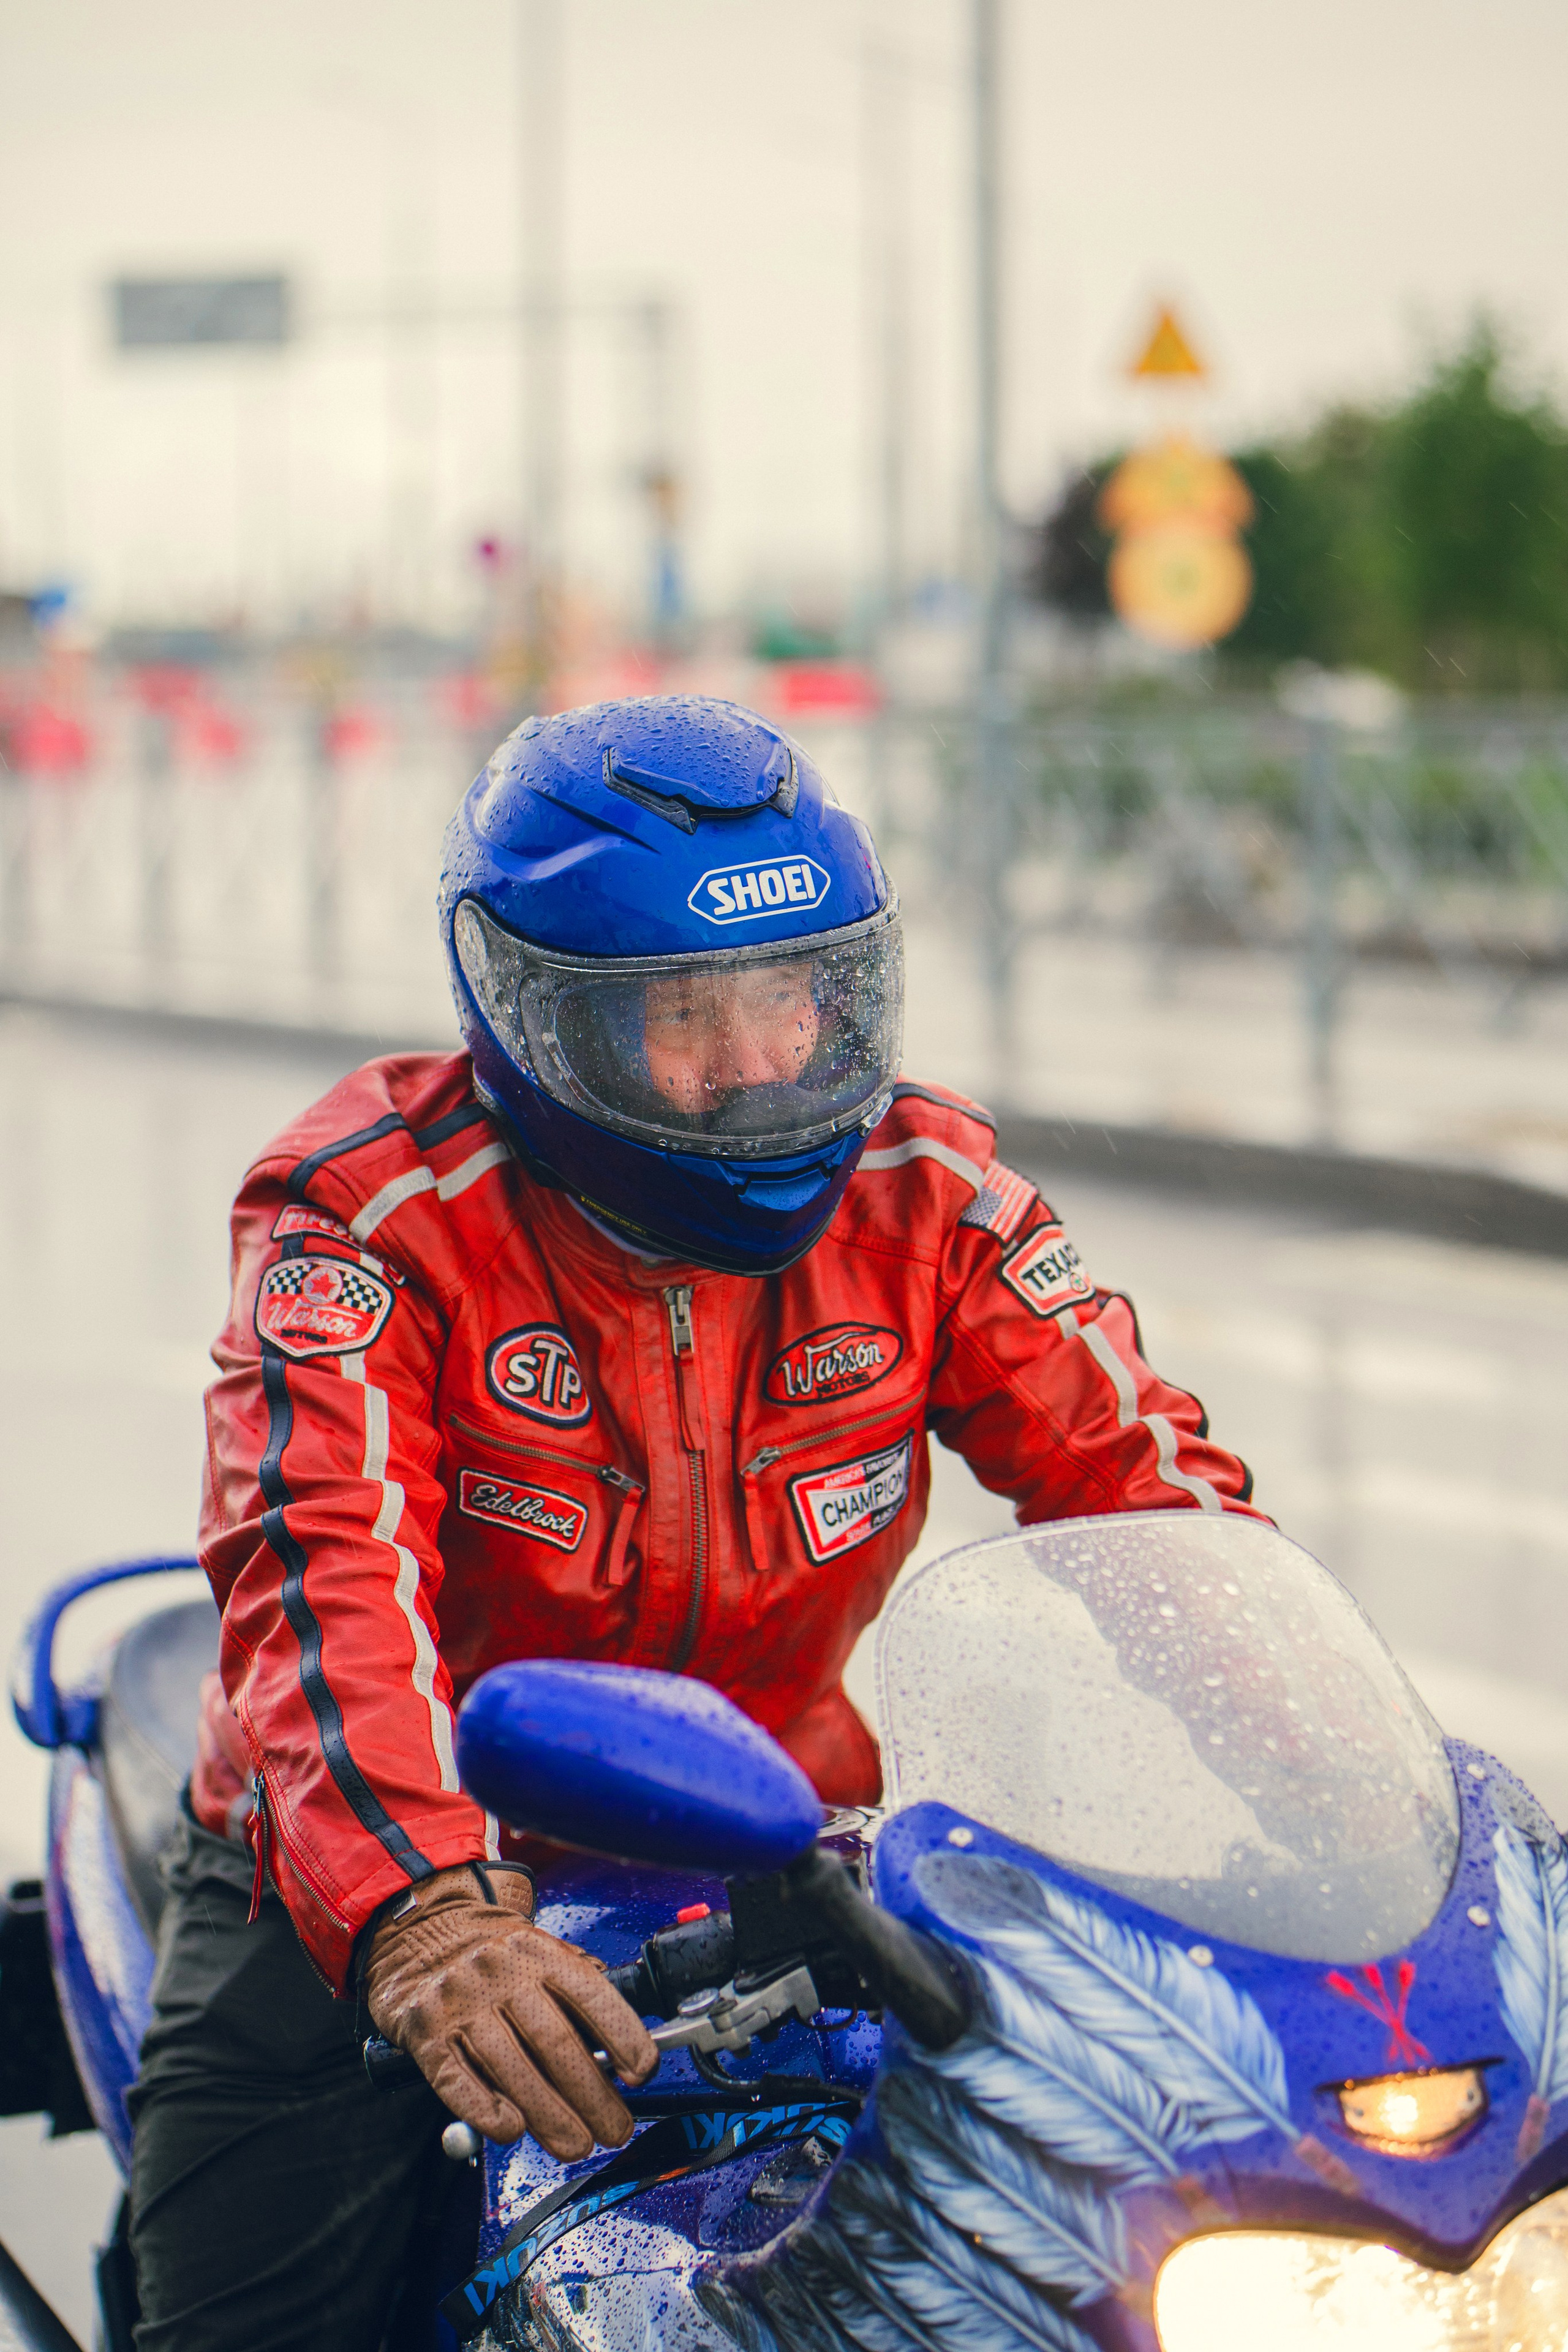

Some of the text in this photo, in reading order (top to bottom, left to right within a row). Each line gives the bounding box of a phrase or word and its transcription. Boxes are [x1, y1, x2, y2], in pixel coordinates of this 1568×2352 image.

[707, 864, 816, 916] SHOEI
[1020, 1242, 1081, 1291] TEXAC
[266, 1297, 363, 1338] Warson
[504, 1338, 582, 1410] STP
[776, 1331, 886, 1397] Warson
[815, 1371, 870, 1398] MOTORS
[470, 1482, 578, 1539] Edelbrock
[463, 2180, 640, 2316] SUZUKI
